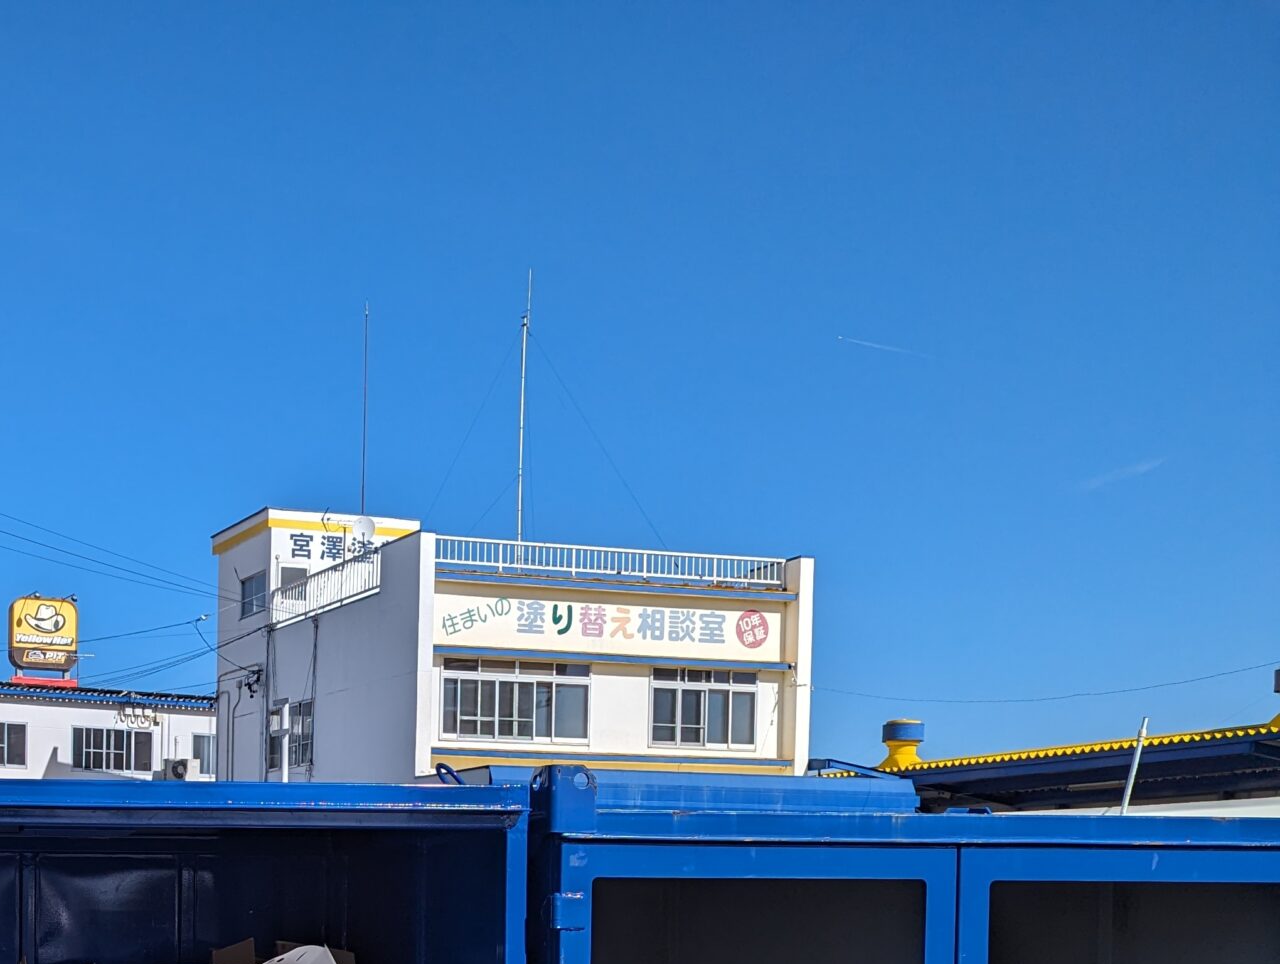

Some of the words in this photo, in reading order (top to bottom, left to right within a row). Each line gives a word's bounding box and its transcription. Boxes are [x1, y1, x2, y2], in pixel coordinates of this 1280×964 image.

[290, 532, 390, 563] 宮澤塗
[442, 597, 511, 636] 住まいの
[516, 600, 726, 644] 塗り替え相談室
